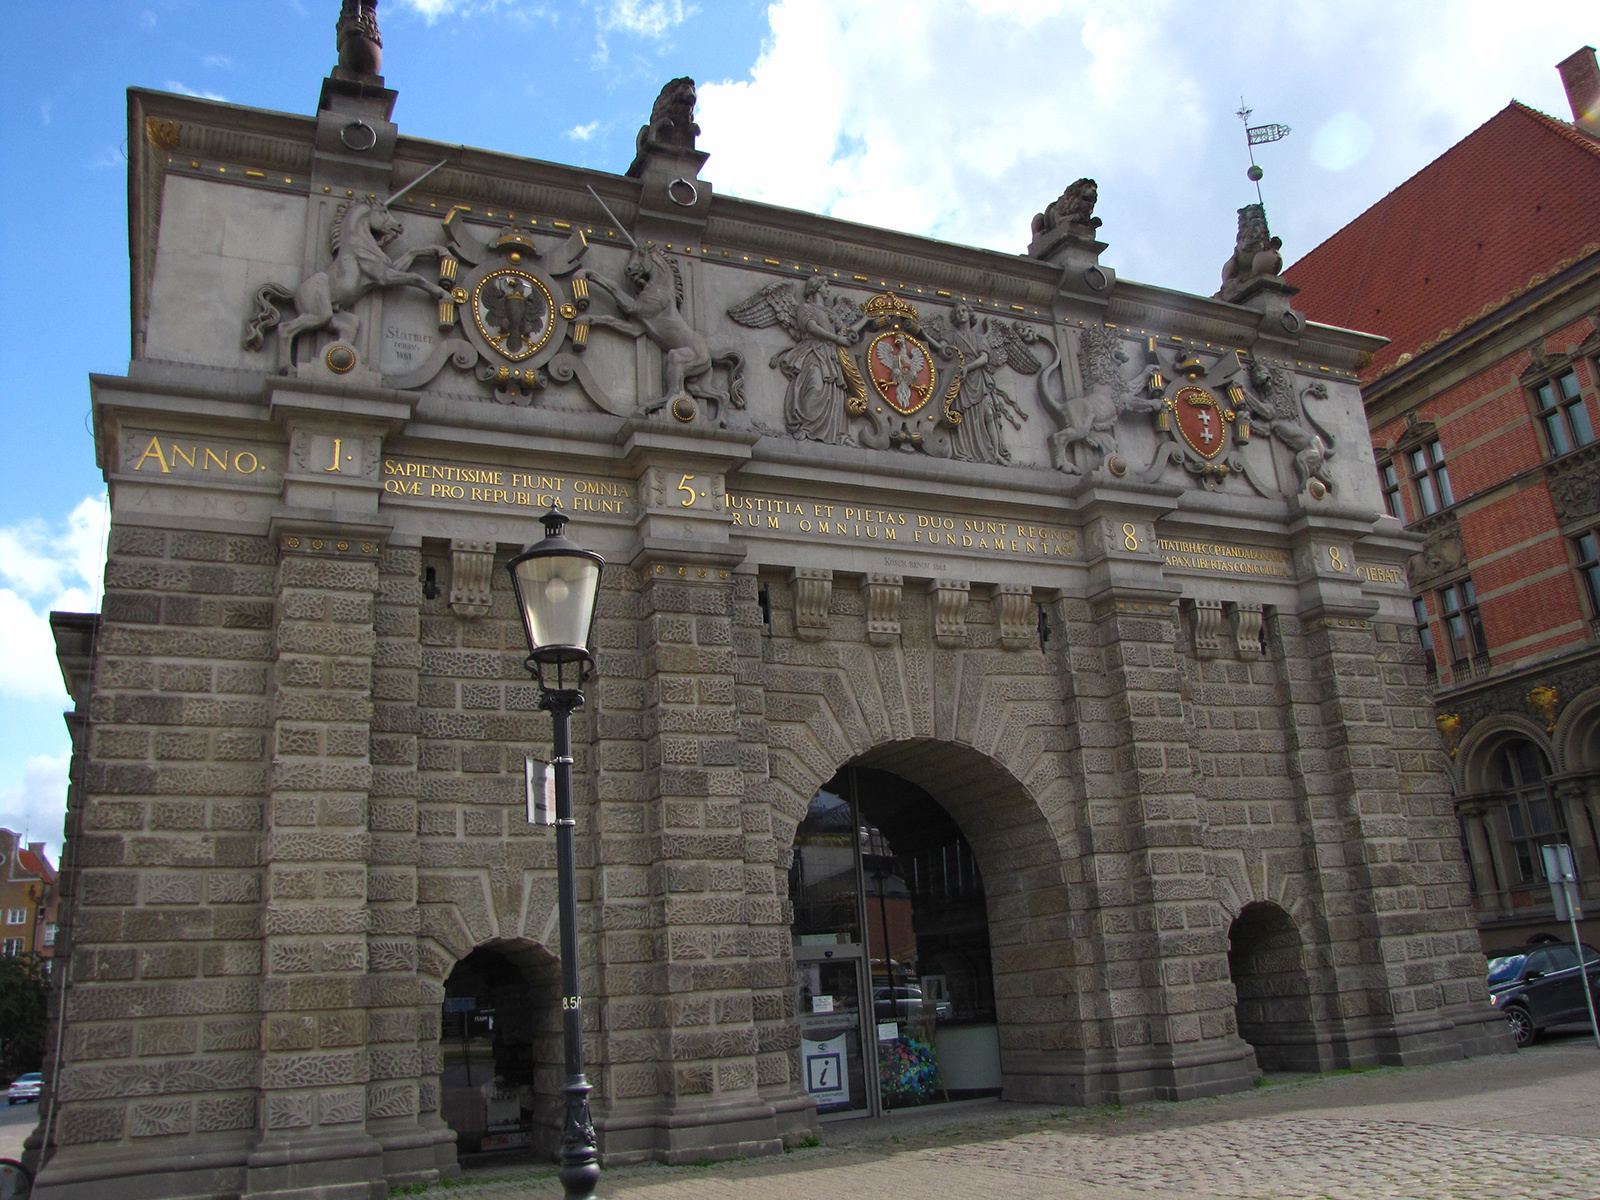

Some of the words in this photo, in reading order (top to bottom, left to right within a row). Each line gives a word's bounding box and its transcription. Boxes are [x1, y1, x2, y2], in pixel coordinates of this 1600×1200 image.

[384, 458, 505, 486] SAPIENTISSIME
[512, 473, 565, 492] FIUNT
[573, 480, 630, 498] OMNIA
[430, 484, 465, 500] PRO
[471, 487, 565, 510] REPUBLICA
[725, 492, 805, 516] IUSTITIA
[813, 504, 834, 518] ET
[845, 507, 906, 526] PIETAS
[917, 514, 955, 531] DUO
[964, 519, 1007, 537] SUNT
[731, 511, 780, 529] RUM
[799, 518, 898, 541] OMNIUM
[913, 530, 1063, 556] FUNDAMENTA
[1191, 557, 1234, 572] LIBERTAS
